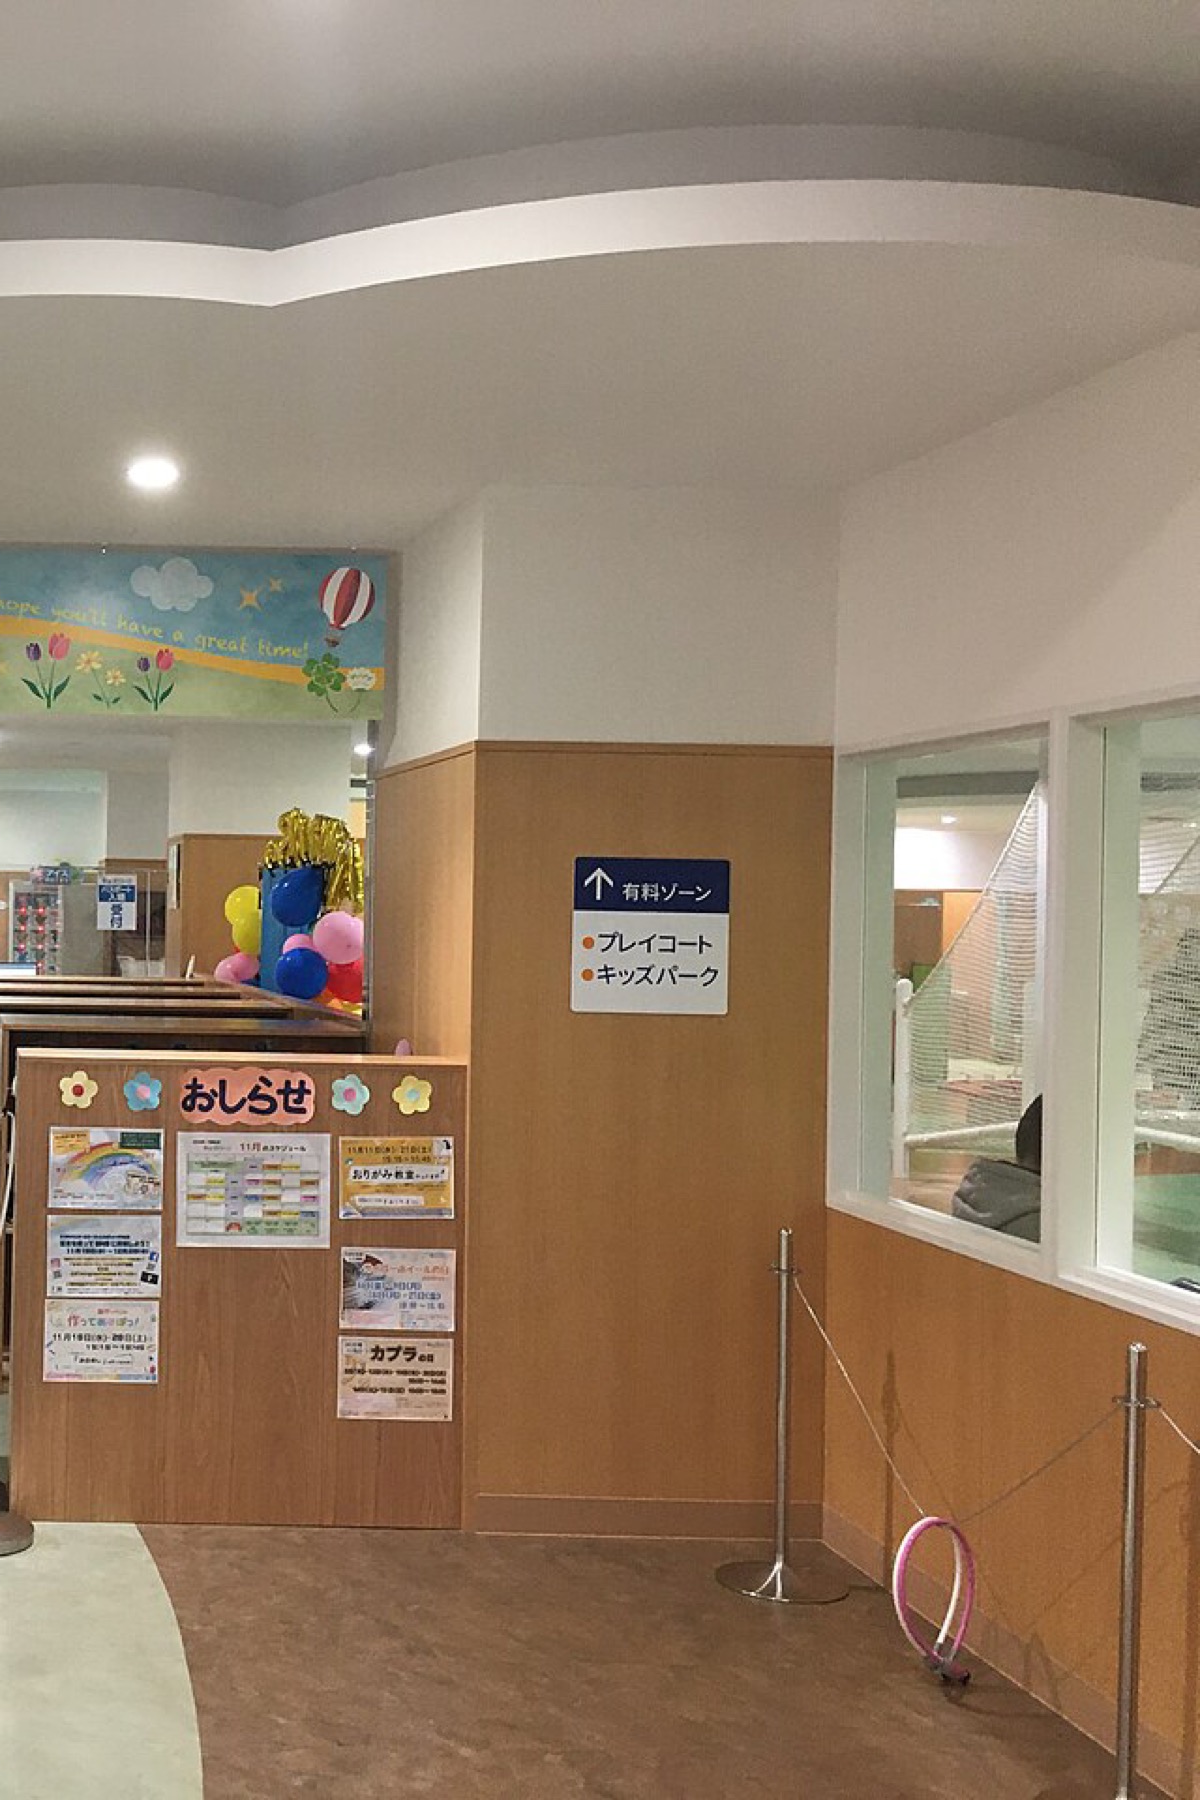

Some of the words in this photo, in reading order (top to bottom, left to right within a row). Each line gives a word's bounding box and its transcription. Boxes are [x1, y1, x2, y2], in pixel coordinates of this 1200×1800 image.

[117, 614, 164, 639] have
[173, 631, 183, 642] a
[196, 633, 248, 654] great
[258, 641, 310, 659] time!
[622, 882, 712, 901] 有料ゾーン
[597, 930, 713, 955] プレイコート
[597, 964, 719, 987] キッズパーク
[181, 1076, 312, 1116] おしらせ
